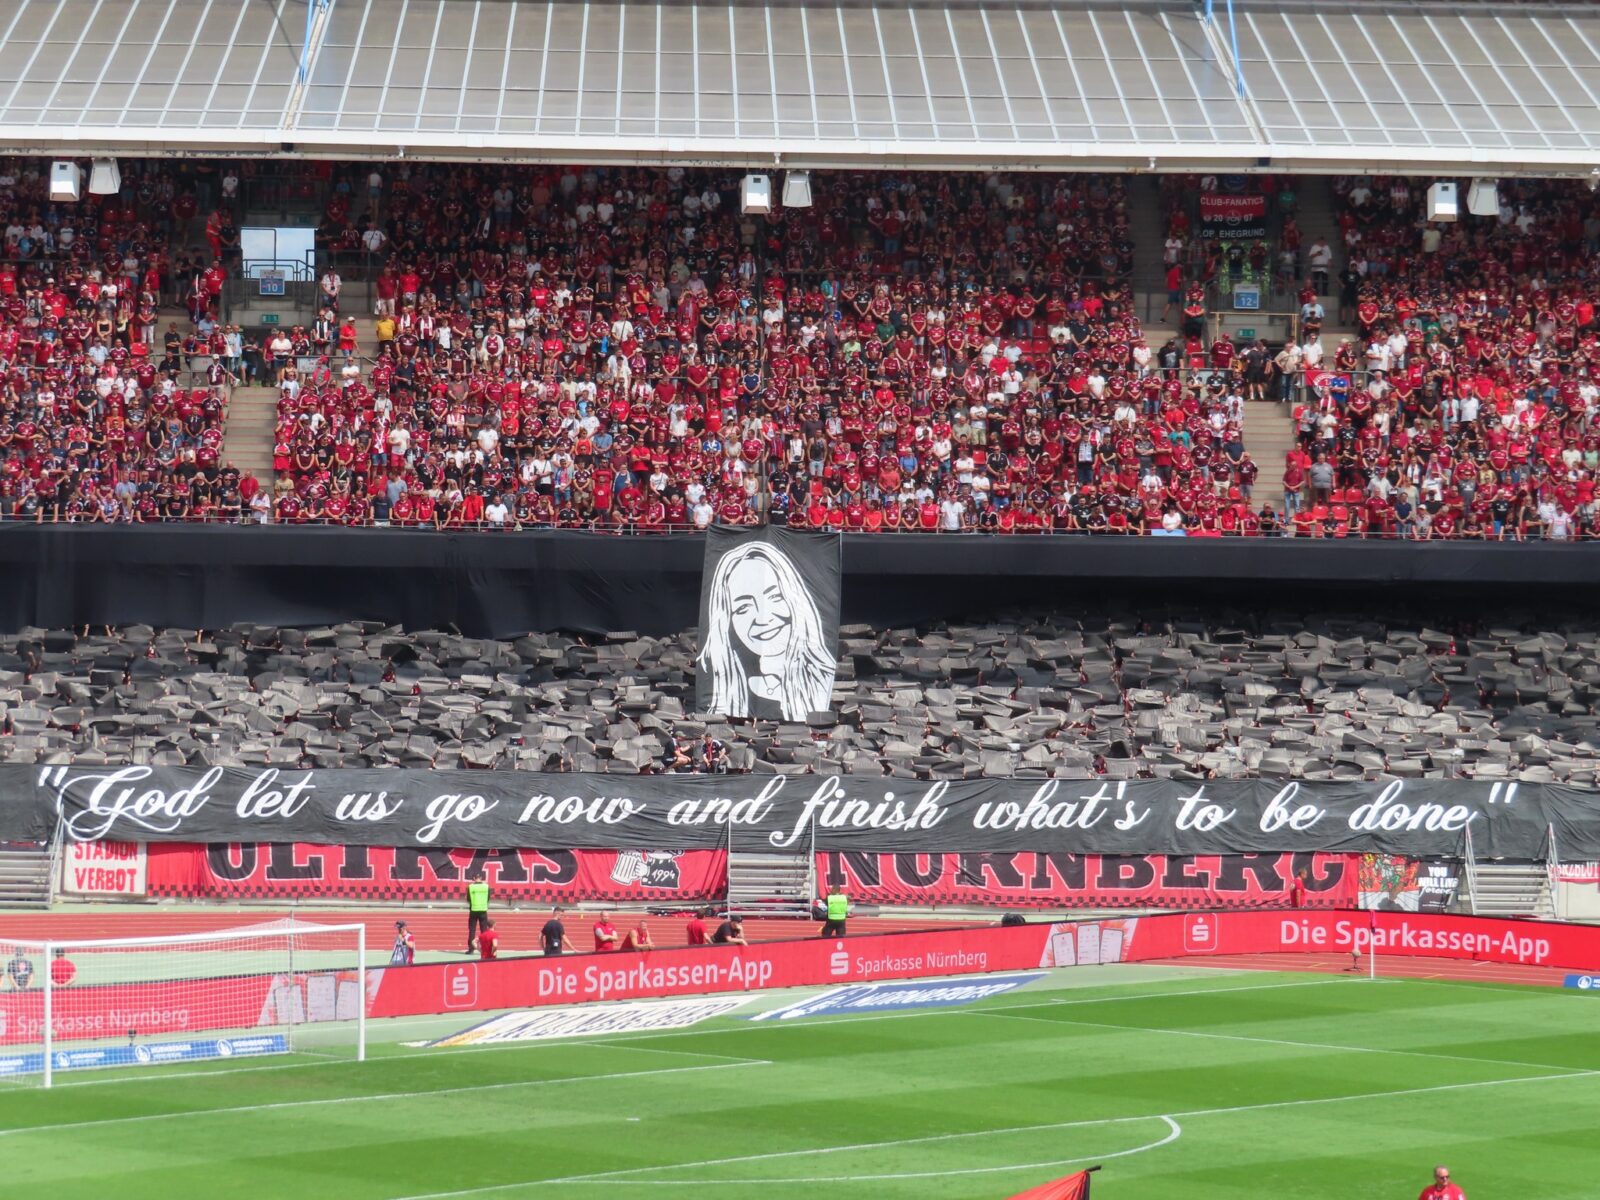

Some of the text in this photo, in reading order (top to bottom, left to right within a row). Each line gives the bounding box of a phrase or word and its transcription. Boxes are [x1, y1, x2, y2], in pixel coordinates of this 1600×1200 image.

[1200, 196, 1265, 206] CLUB-FANATICS
[266, 283, 278, 292] 10
[1241, 297, 1252, 306] 12
[236, 768, 316, 819] let
[335, 789, 404, 821] us
[416, 792, 499, 843] go
[518, 793, 647, 825] now
[667, 775, 788, 827] and
[768, 775, 951, 849] finish
[973, 778, 1151, 832] what's
[1175, 784, 1236, 832] to
[1259, 781, 1326, 832] be
[74, 841, 138, 861] STADION
[74, 868, 137, 892] VERBOT
[651, 868, 676, 882] 1994
[1427, 866, 1448, 877] YOU
[1280, 919, 1327, 946] Die
[1334, 920, 1550, 962] Sparkassen-App
[856, 954, 923, 977] Sparkasse
[926, 950, 988, 971] Nürnberg
[538, 967, 578, 997] Die
[584, 956, 773, 998] Sparkassen-App
[109, 1007, 188, 1028] Nürnberg
